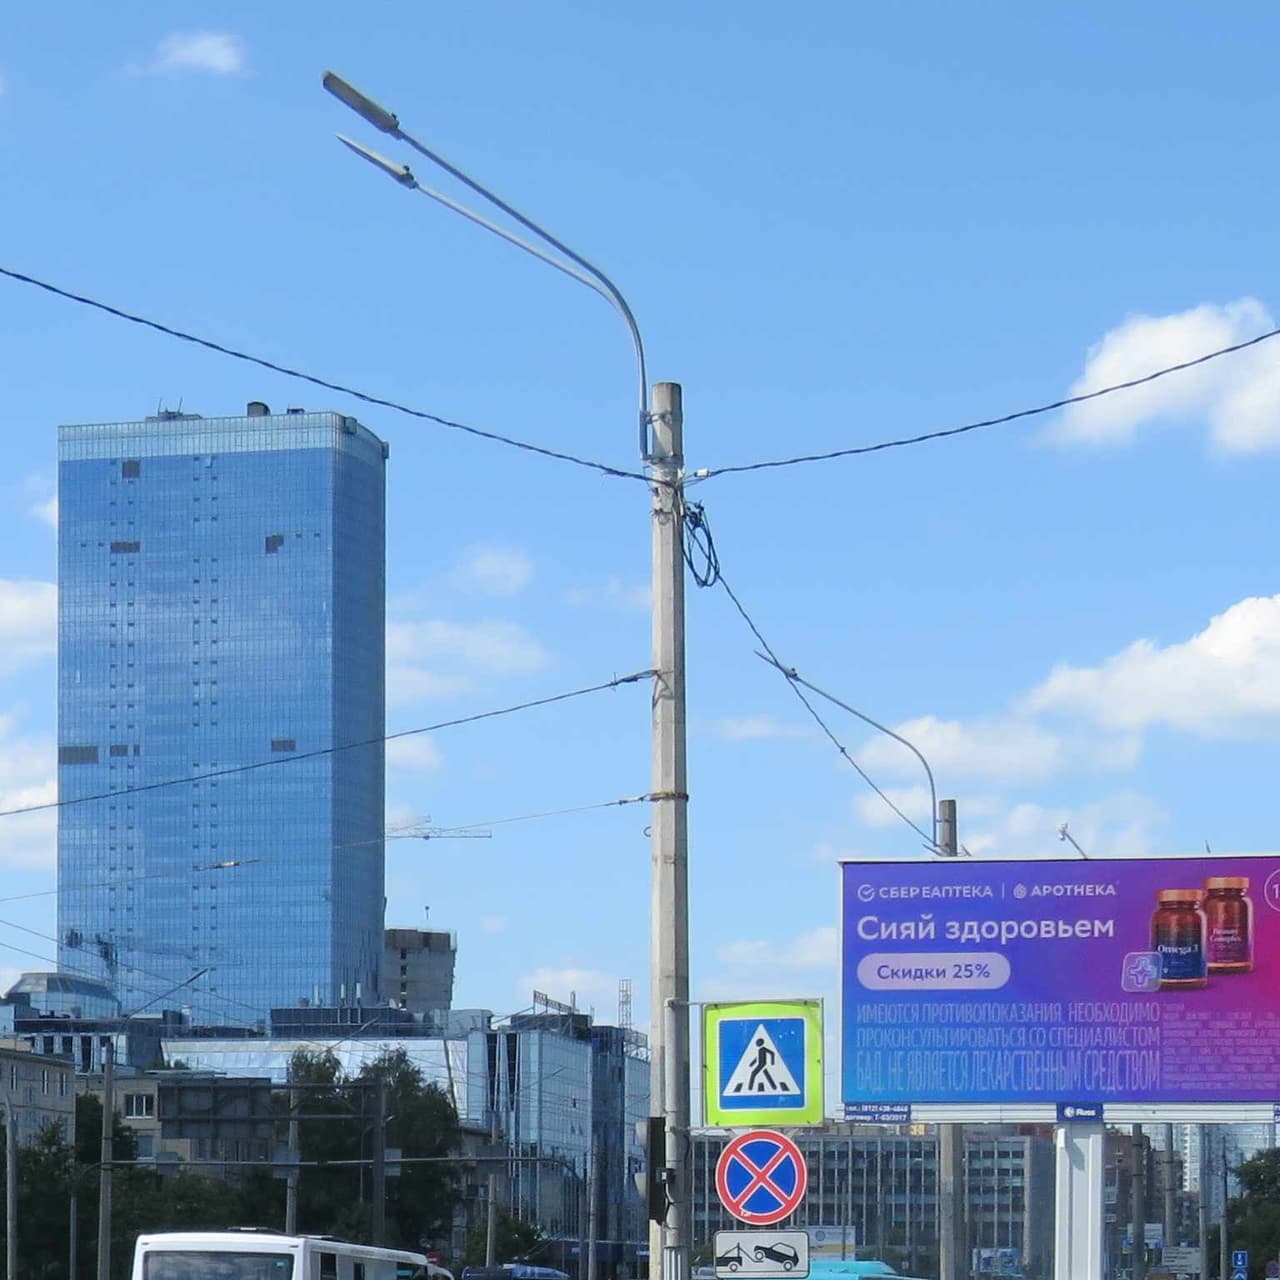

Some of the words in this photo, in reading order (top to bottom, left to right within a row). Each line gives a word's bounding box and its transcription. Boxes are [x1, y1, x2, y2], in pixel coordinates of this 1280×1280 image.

[857, 913, 936, 940] Сияй
[945, 918, 1115, 945] здоровьем
[876, 965, 947, 982] Скидки
[952, 963, 991, 979] 25%
[856, 1003, 919, 1024] ИМЕЮТСЯ
[1069, 1002, 1160, 1025] НЕОБХОДИМО
[856, 1027, 1026, 1048] ПРОКОНСУЛЬТИРОВАТЬСЯ
[1029, 1027, 1046, 1047] СО
[1049, 1026, 1160, 1049] СПЕЦИАЛИСТОМ
[888, 1051, 905, 1091] НЕ
[907, 1051, 969, 1091] ЯВЛЯЕТСЯ
[971, 1050, 1081, 1091] ЛЕКАРСТВЕННЫМ
[1084, 1050, 1160, 1093] СРЕДСТВОМ
